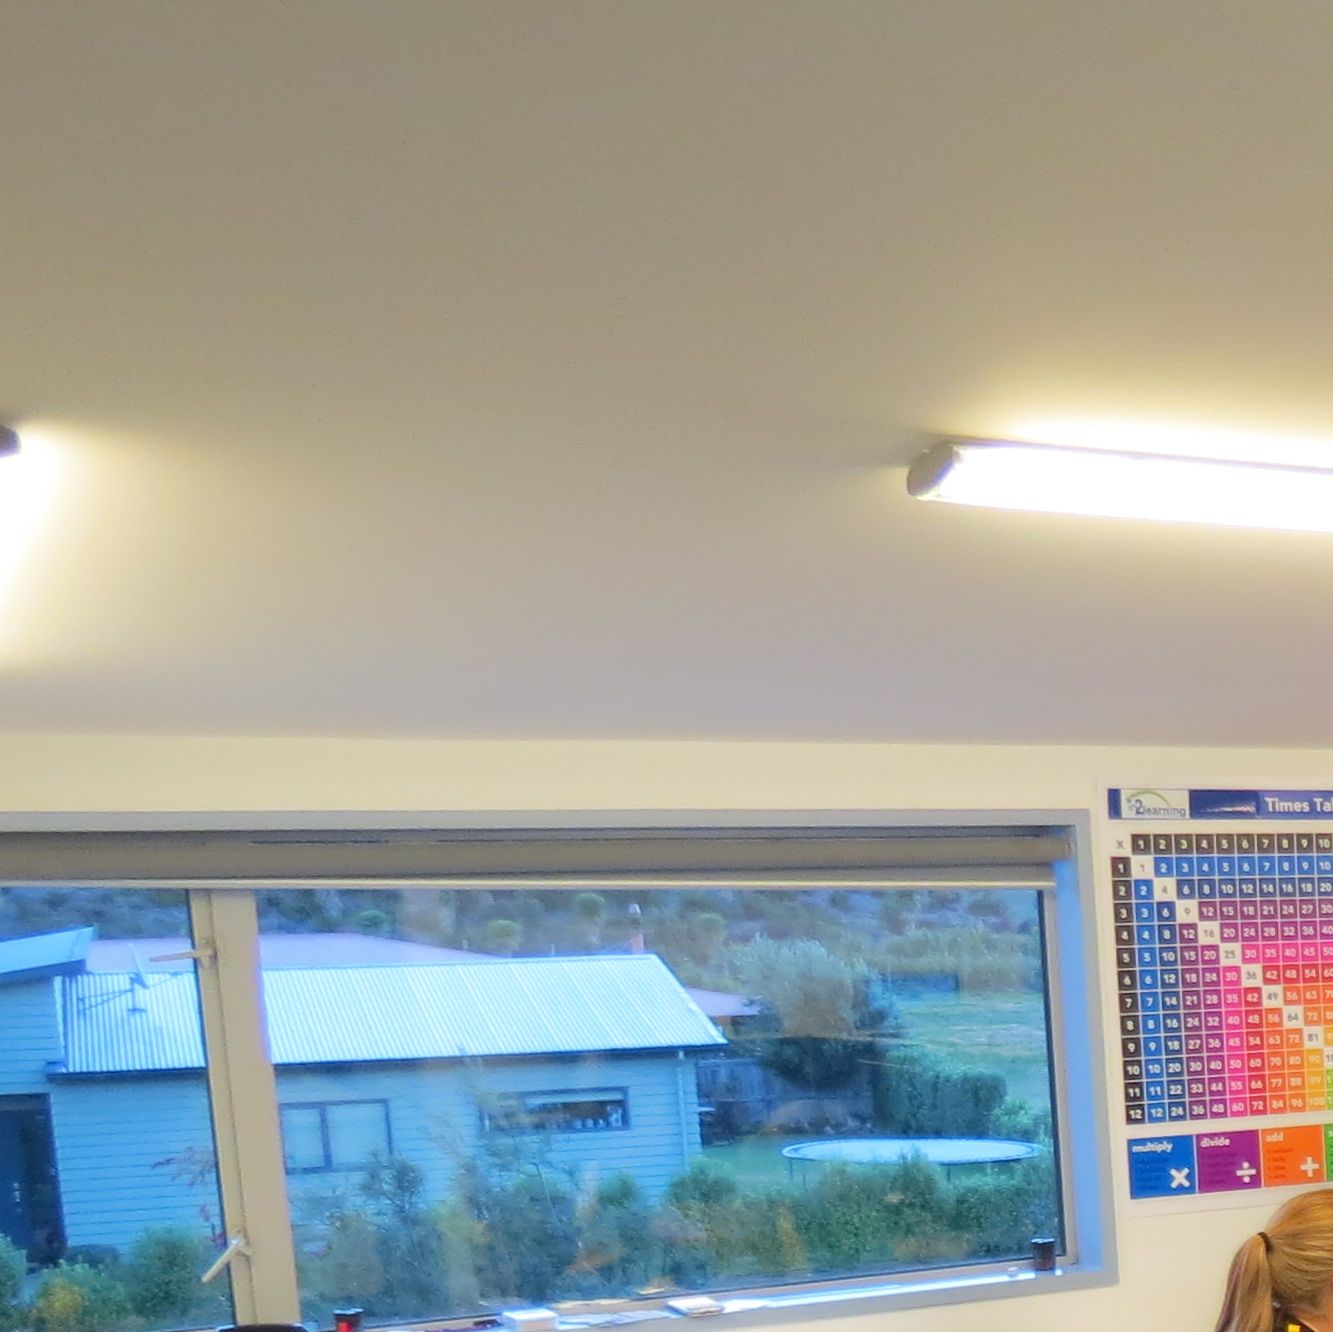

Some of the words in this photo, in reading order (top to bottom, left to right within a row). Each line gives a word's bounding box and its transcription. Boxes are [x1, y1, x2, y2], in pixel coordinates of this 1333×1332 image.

[1264, 796, 1311, 814] Times
[1137, 839, 1144, 849] 1
[1158, 838, 1166, 849] 2
[1180, 838, 1187, 849] 3
[1200, 838, 1208, 849] 4
[1221, 838, 1228, 849] 5
[1241, 838, 1249, 849] 6
[1261, 838, 1269, 848] 7
[1281, 838, 1288, 848] 8
[1300, 838, 1308, 848] 9
[1318, 838, 1330, 848] 10
[1117, 862, 1124, 873] 1
[1159, 862, 1167, 873] 2
[1181, 862, 1189, 872] 3
[1201, 862, 1209, 872] 4
[1222, 862, 1229, 872] 5
[1242, 862, 1249, 871] 6
[1262, 861, 1270, 871] 7
[1282, 861, 1289, 871] 8
[1301, 861, 1309, 870] 9
[1318, 860, 1331, 870] 10
[1118, 885, 1126, 896] 2
[1139, 885, 1147, 895] 2
[1182, 884, 1190, 895] 6
[1202, 883, 1210, 894] 8
[1220, 883, 1233, 893] 10
[1241, 883, 1253, 893] 12
[1261, 883, 1274, 893] 14
[1281, 883, 1293, 892] 16
[1300, 882, 1312, 892] 18
[1319, 882, 1332, 892] 20
[1119, 908, 1127, 918] 3
[1140, 907, 1148, 918] 3
[1161, 907, 1170, 917] 6
[1201, 906, 1214, 916] 12
[1221, 906, 1234, 916] 15
[1242, 905, 1255, 915] 18
[1262, 904, 1274, 915] 21
[1281, 904, 1294, 914] 24
[1301, 904, 1313, 914] 27
[1320, 903, 1333, 913] 30
[1120, 930, 1128, 940] 4
[1141, 930, 1149, 939] 4
[1162, 929, 1170, 939] 8
[1182, 928, 1195, 938] 12
[1122, 952, 1130, 963] 5
[1143, 952, 1151, 962] 5
[1161, 951, 1175, 961] 10
[1182, 950, 1196, 960] 15
[1123, 974, 1131, 985] 6
[1144, 975, 1152, 984] 6
[1163, 973, 1176, 983] 12
[1184, 972, 1197, 982] 18
[1124, 997, 1132, 1008] 7
[1145, 996, 1153, 1006] 7
[1164, 996, 1177, 1005] 14
[1184, 995, 1197, 1005] 21
[1125, 1020, 1134, 1030] 8
[1147, 1019, 1155, 1029] 8
[1165, 1018, 1179, 1028] 16
[1185, 1016, 1199, 1027] 24
[1127, 1042, 1135, 1052] 9
[1148, 1041, 1156, 1051] 9
[1166, 1040, 1179, 1050] 18
[1187, 1038, 1201, 1049] 27
[1126, 1064, 1140, 1075] 10
[1147, 1063, 1161, 1073] 10
[1167, 1062, 1181, 1073] 20
[1188, 1061, 1202, 1071] 30
[1127, 1087, 1140, 1097] 11
[1148, 1085, 1161, 1095] 11
[1169, 1084, 1182, 1094] 22
[1190, 1083, 1203, 1093] 33
[1128, 1108, 1142, 1119] 12
[1150, 1107, 1163, 1117] 12
[1170, 1106, 1184, 1116] 24
[1191, 1104, 1205, 1115] 36
[1200, 1136, 1231, 1149] divide
[1265, 1132, 1284, 1143] add
[1131, 1141, 1174, 1154] multiply
